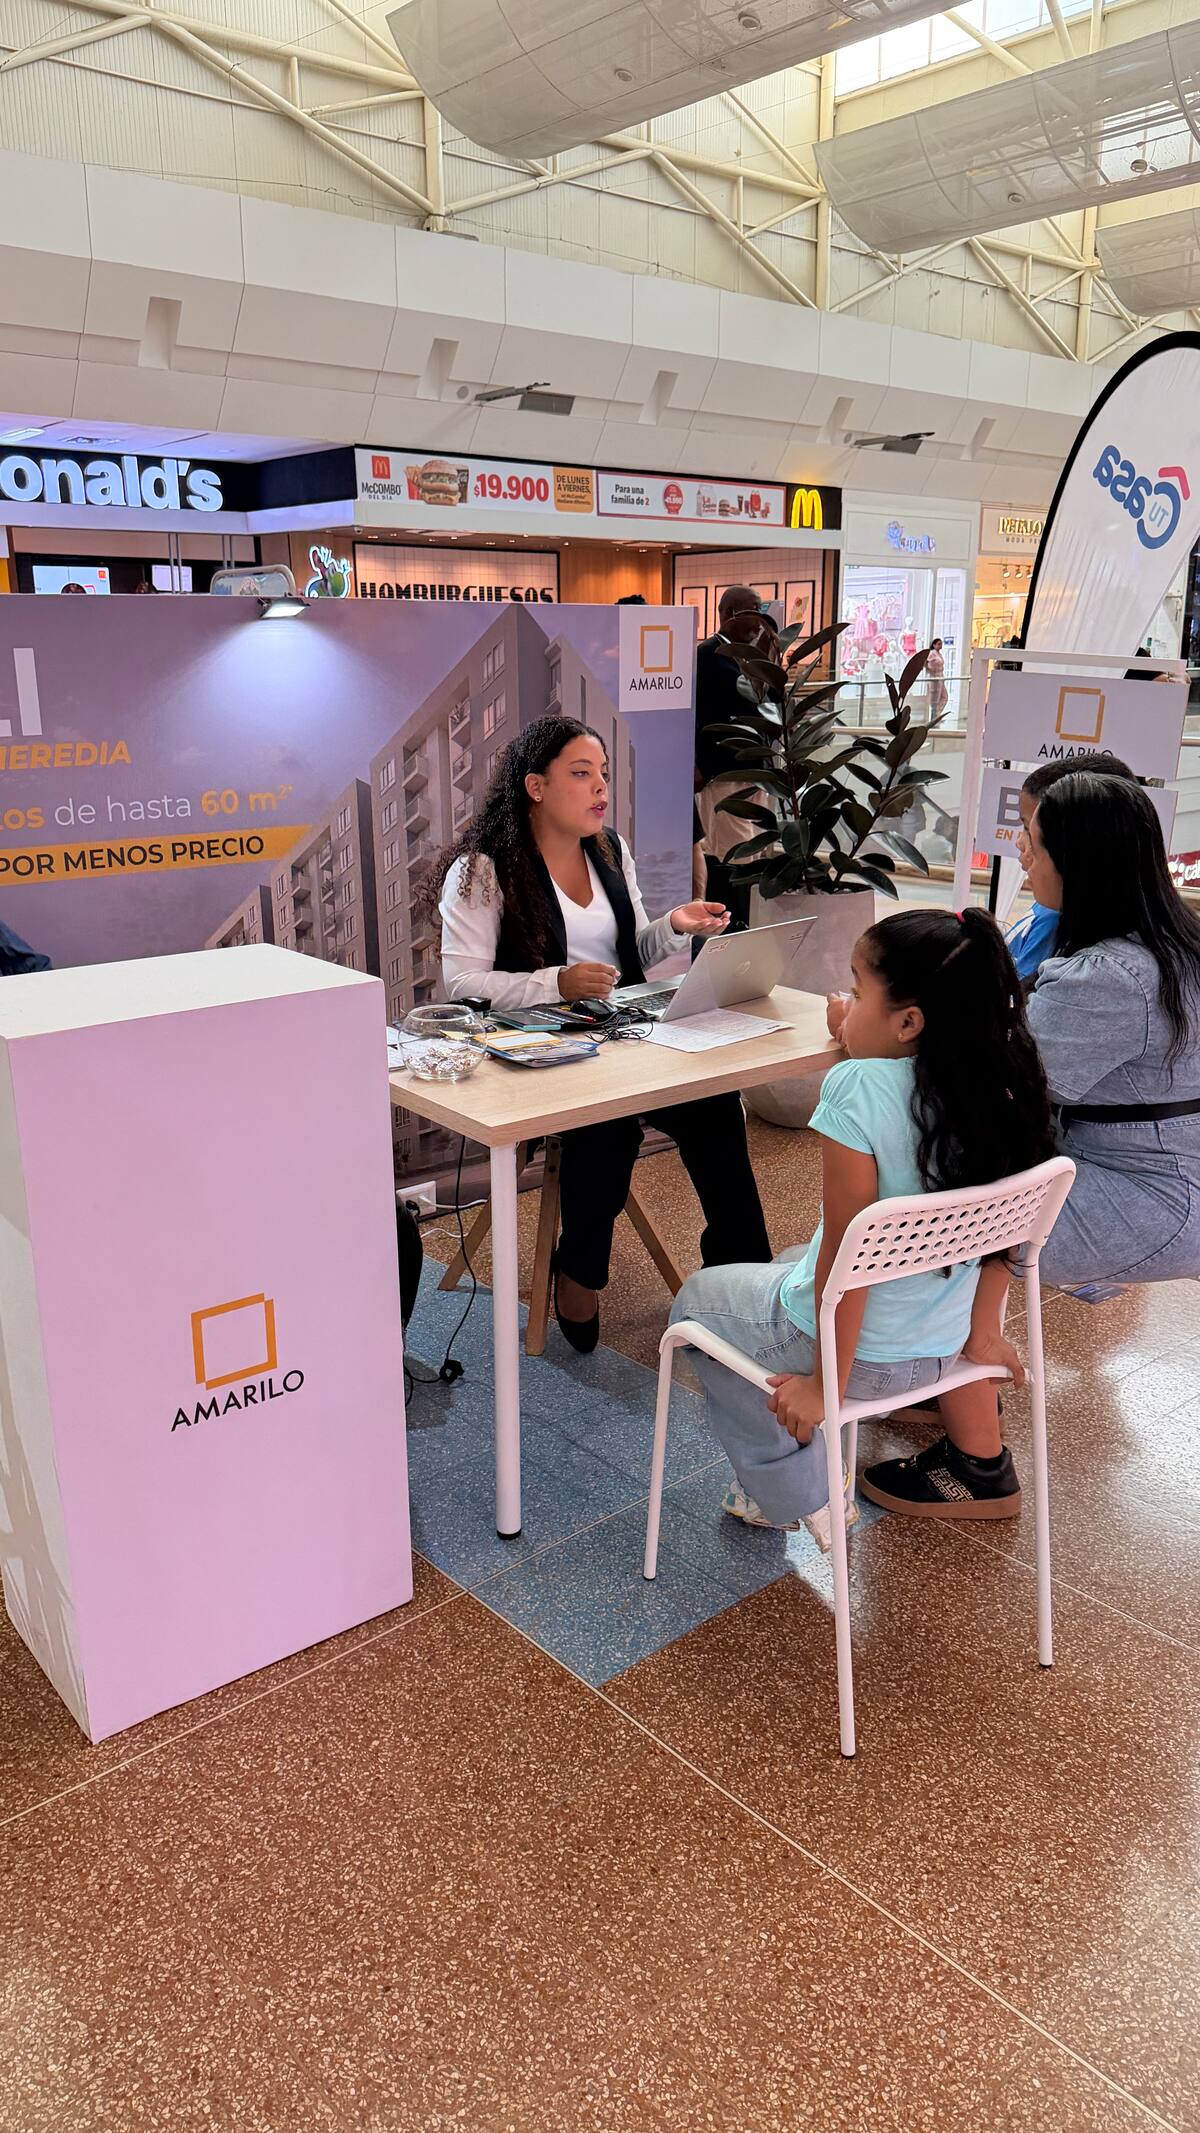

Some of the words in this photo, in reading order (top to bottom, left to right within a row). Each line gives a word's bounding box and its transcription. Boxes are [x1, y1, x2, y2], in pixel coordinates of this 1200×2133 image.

[556, 474, 566, 484] DE
[567, 475, 590, 485] LUNES
[557, 483, 563, 491] A
[474, 473, 550, 502] $19.900
[614, 484, 631, 495] Para
[632, 487, 644, 495] una
[611, 494, 634, 505] familia
[635, 496, 644, 506] de
[645, 498, 650, 506] 2
[628, 676, 683, 691] AMARILO
[0, 647, 43, 737] I
[0, 806, 45, 831] os
[54, 798, 96, 826] de
[106, 794, 192, 823] hasta
[201, 788, 239, 817] 60
[995, 829, 1013, 841] EN
[64, 843, 164, 872] MENOS
[171, 835, 264, 861] PRECIO
[170, 1369, 305, 1432] AMARILO
